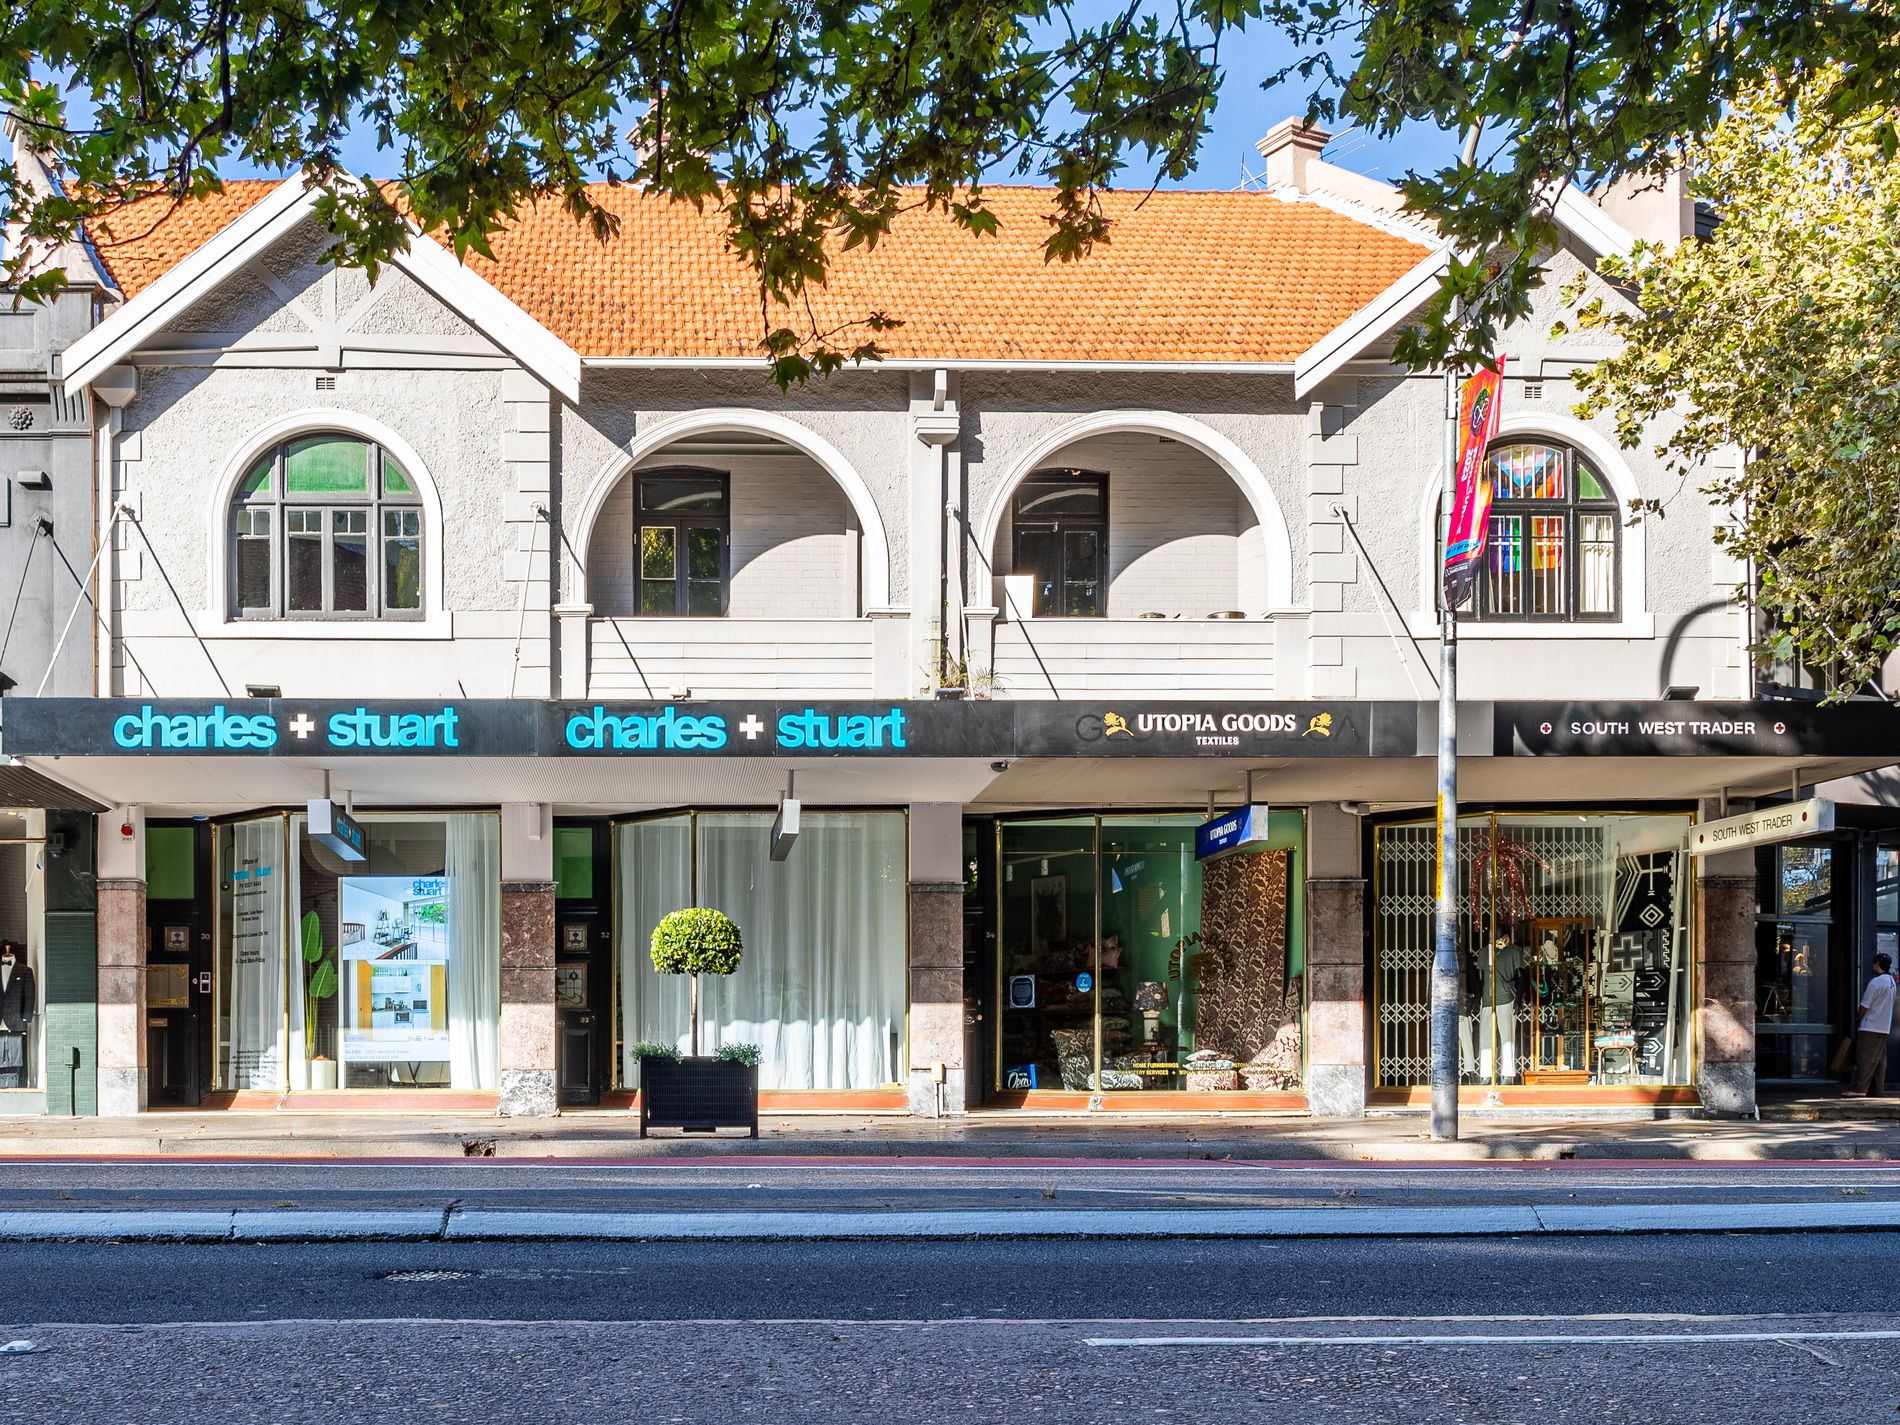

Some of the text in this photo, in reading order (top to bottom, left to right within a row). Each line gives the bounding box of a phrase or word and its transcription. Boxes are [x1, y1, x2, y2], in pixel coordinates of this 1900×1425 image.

[112, 703, 278, 750] charles
[327, 706, 459, 748] stuart
[565, 705, 728, 750] charles
[776, 707, 907, 750] stuart
[1137, 713, 1297, 732] UTOPIA GOODS
[1570, 721, 1756, 736] SOUTH WEST TRADER
[1195, 736, 1240, 746] TEXTILES
[1210, 820, 1238, 840] UTOPIA GOODS
[1712, 814, 1793, 842] SOUTH WEST TRADER
[1008, 1072, 1032, 1089] Open
